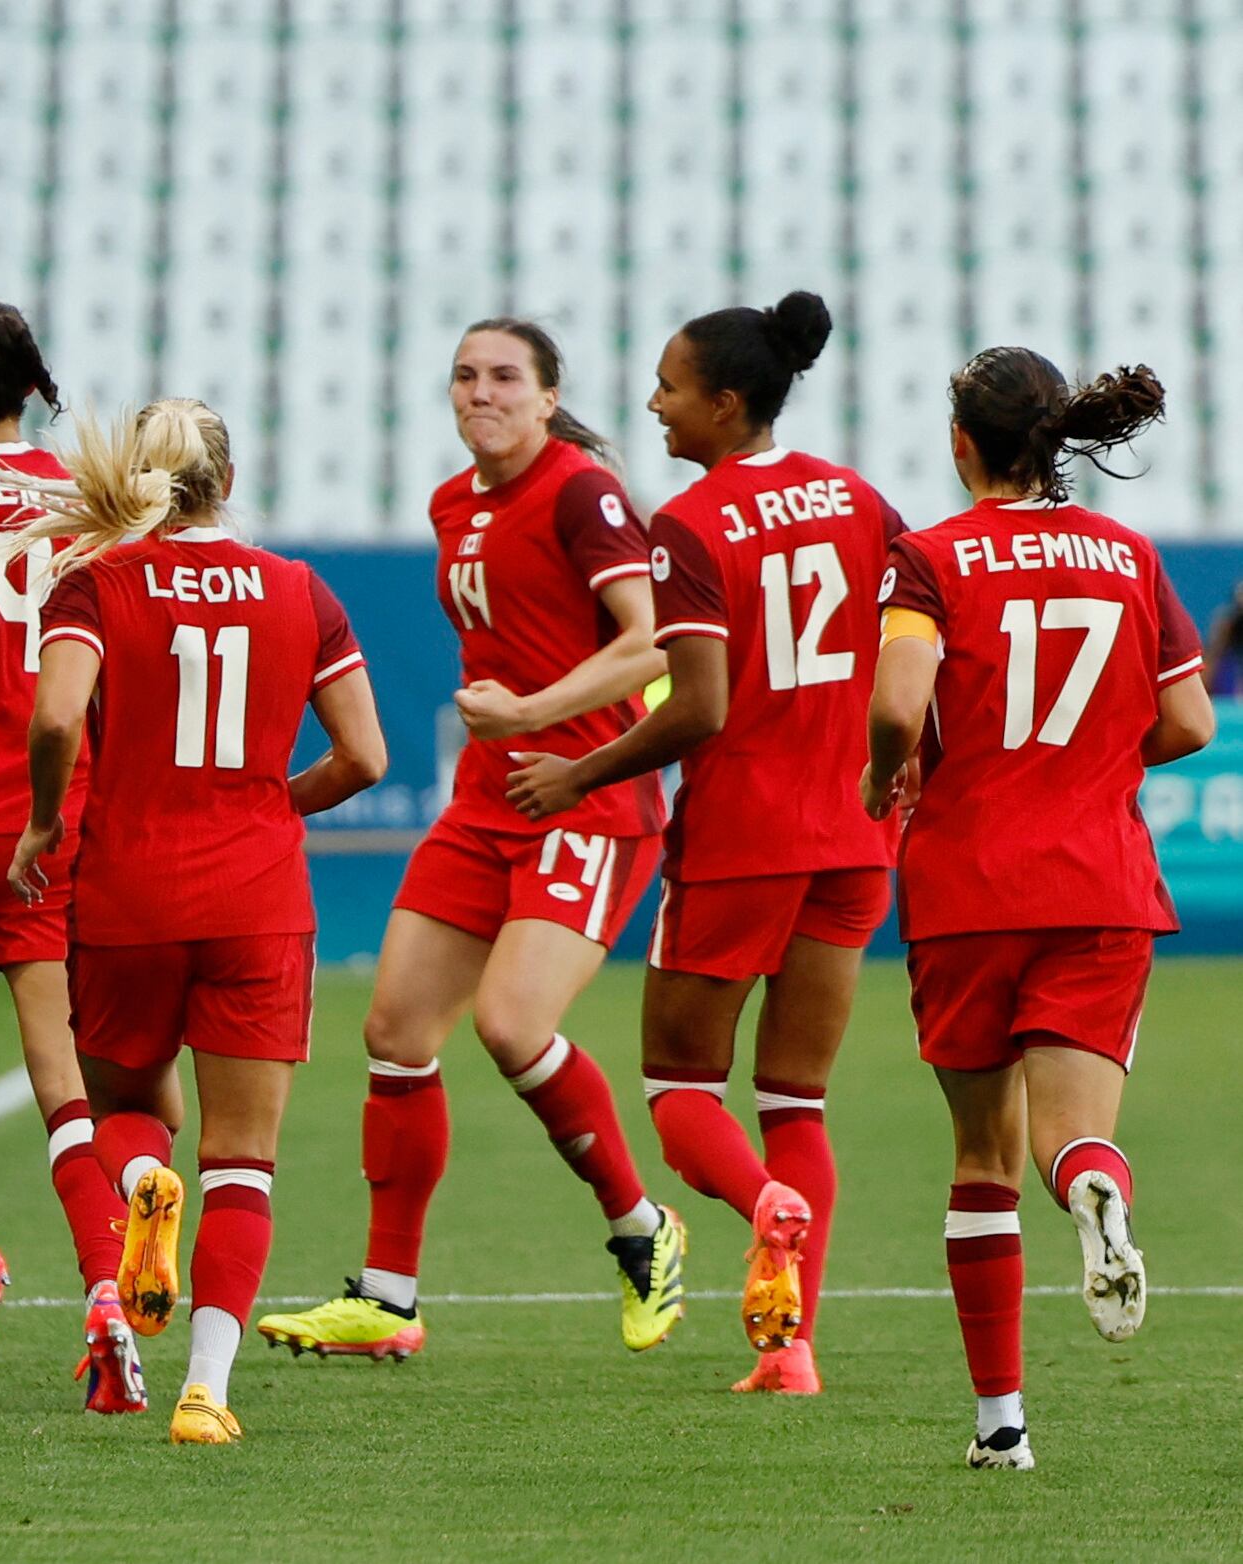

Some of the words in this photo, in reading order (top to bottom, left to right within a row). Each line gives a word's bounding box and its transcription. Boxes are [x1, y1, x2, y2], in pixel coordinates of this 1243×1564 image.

[720, 503, 758, 543] J.
[754, 478, 855, 530] ROSE
[143, 563, 265, 603] LEON
[953, 532, 1138, 580] FLEMING
[448, 560, 493, 630] 14
[760, 542, 856, 691] 12
[170, 624, 250, 769] 11
[999, 597, 1125, 750] 17
[537, 827, 607, 887] 14
